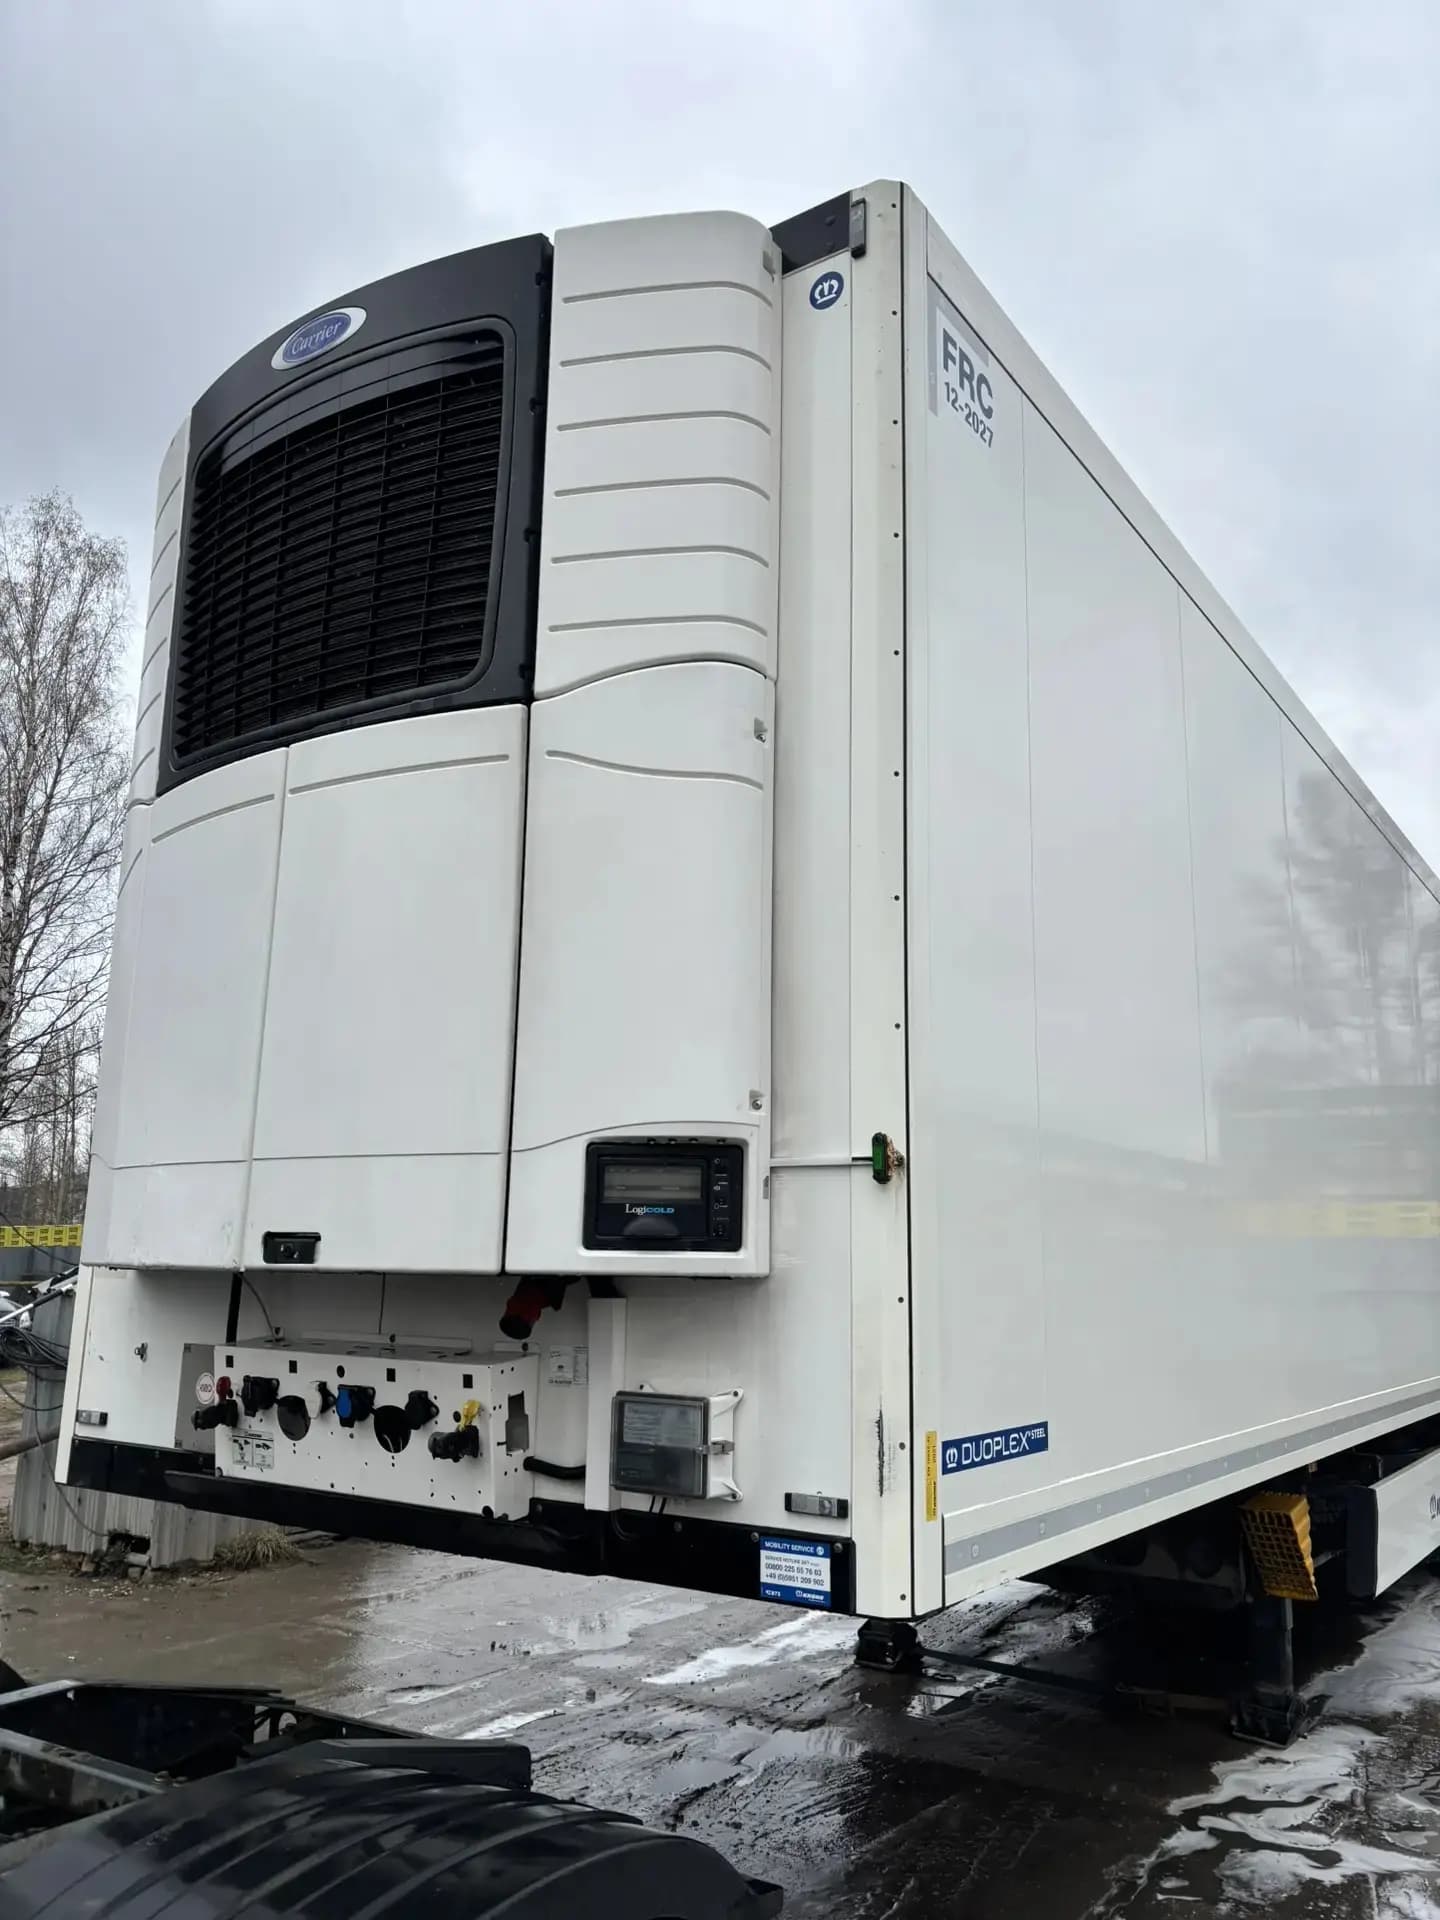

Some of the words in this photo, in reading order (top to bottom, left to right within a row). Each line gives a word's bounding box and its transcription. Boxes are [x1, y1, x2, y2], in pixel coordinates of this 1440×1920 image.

[291, 321, 342, 355] Carrier
[943, 327, 993, 420] FRC
[944, 381, 994, 448] 12-2027
[961, 1431, 1030, 1465] DUOPLEX
[1031, 1427, 1046, 1439] STEEL
[764, 1541, 790, 1551] MOBILITY
[791, 1544, 815, 1553] SERVICE
[784, 1564, 795, 1573] 225
